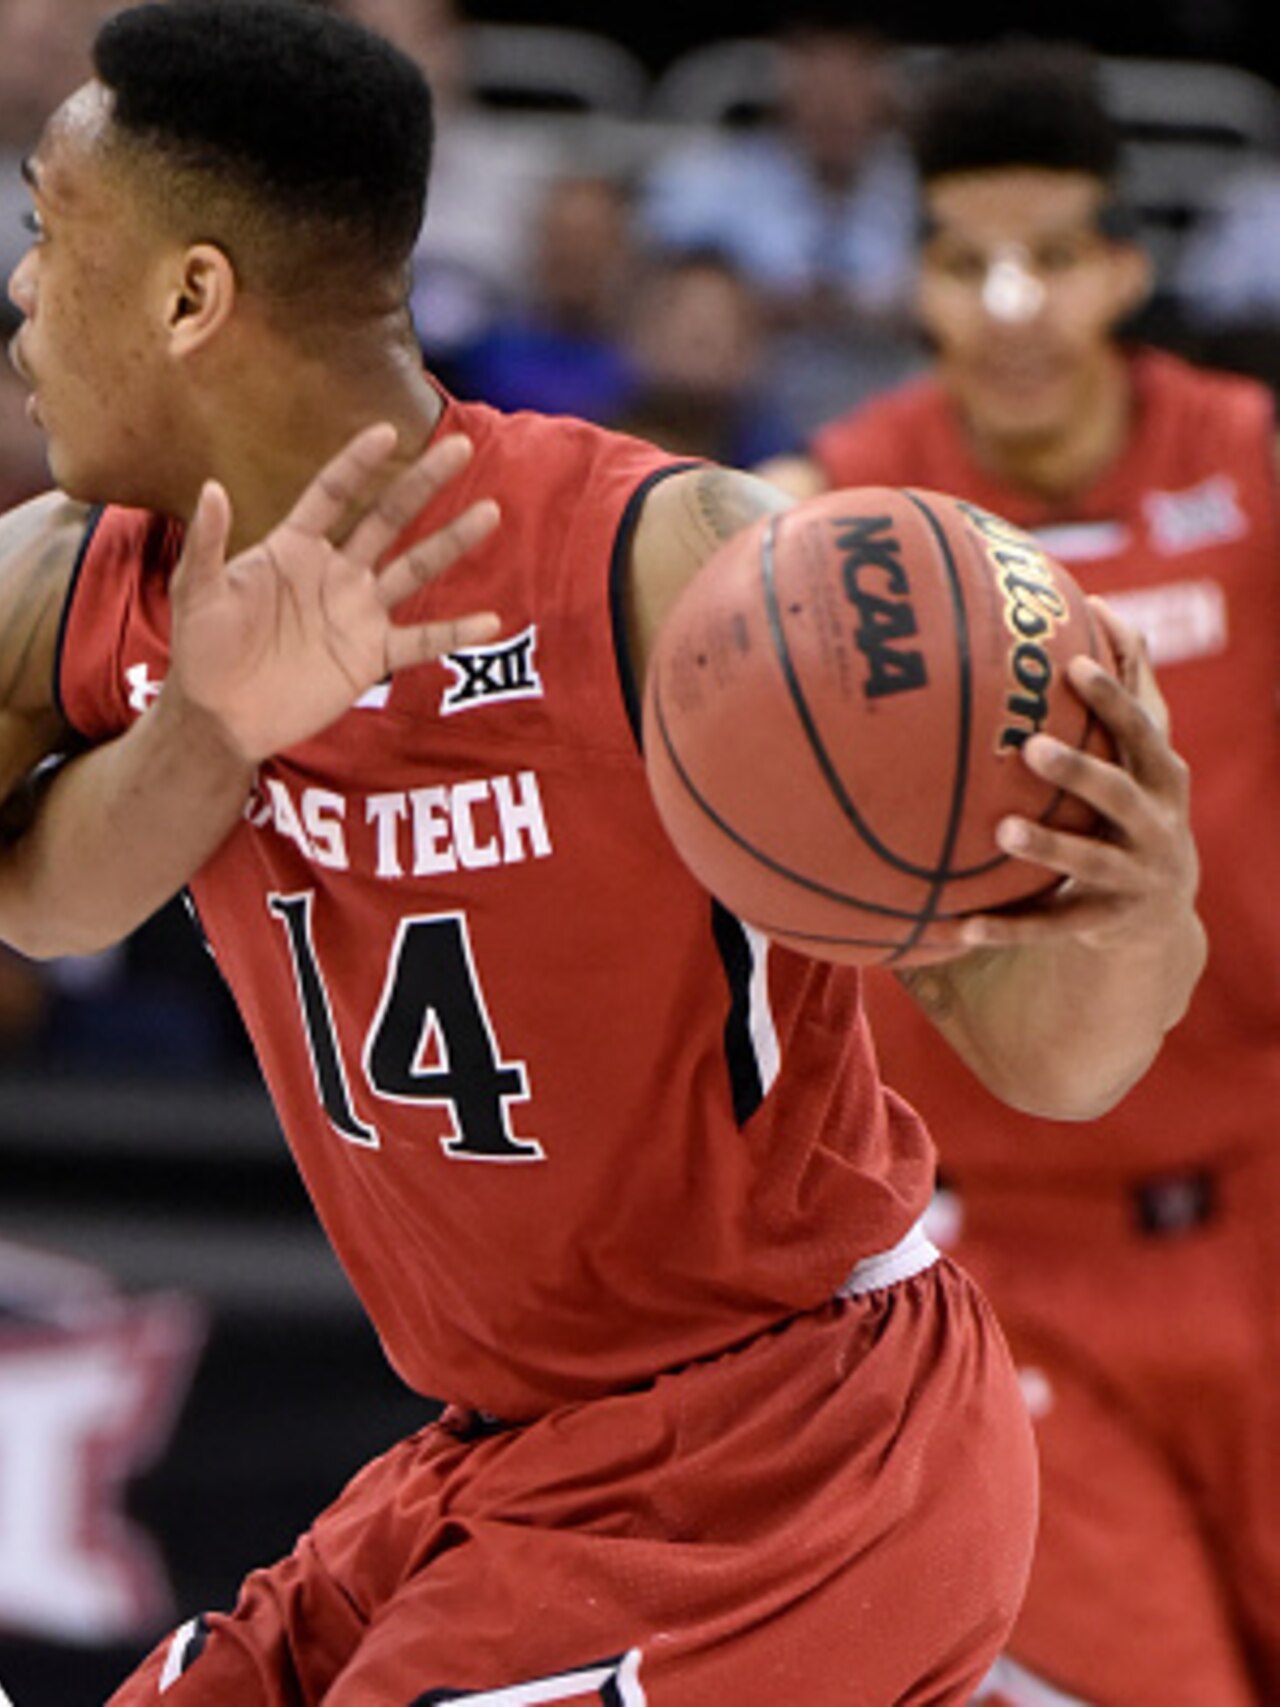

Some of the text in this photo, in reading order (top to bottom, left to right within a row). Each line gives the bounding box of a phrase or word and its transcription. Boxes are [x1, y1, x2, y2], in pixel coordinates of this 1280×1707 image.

[444, 630, 539, 709] XII
[831, 516, 928, 699] NCAA
[246, 768, 552, 878] AS TECH
[267, 887, 547, 1160] 14
